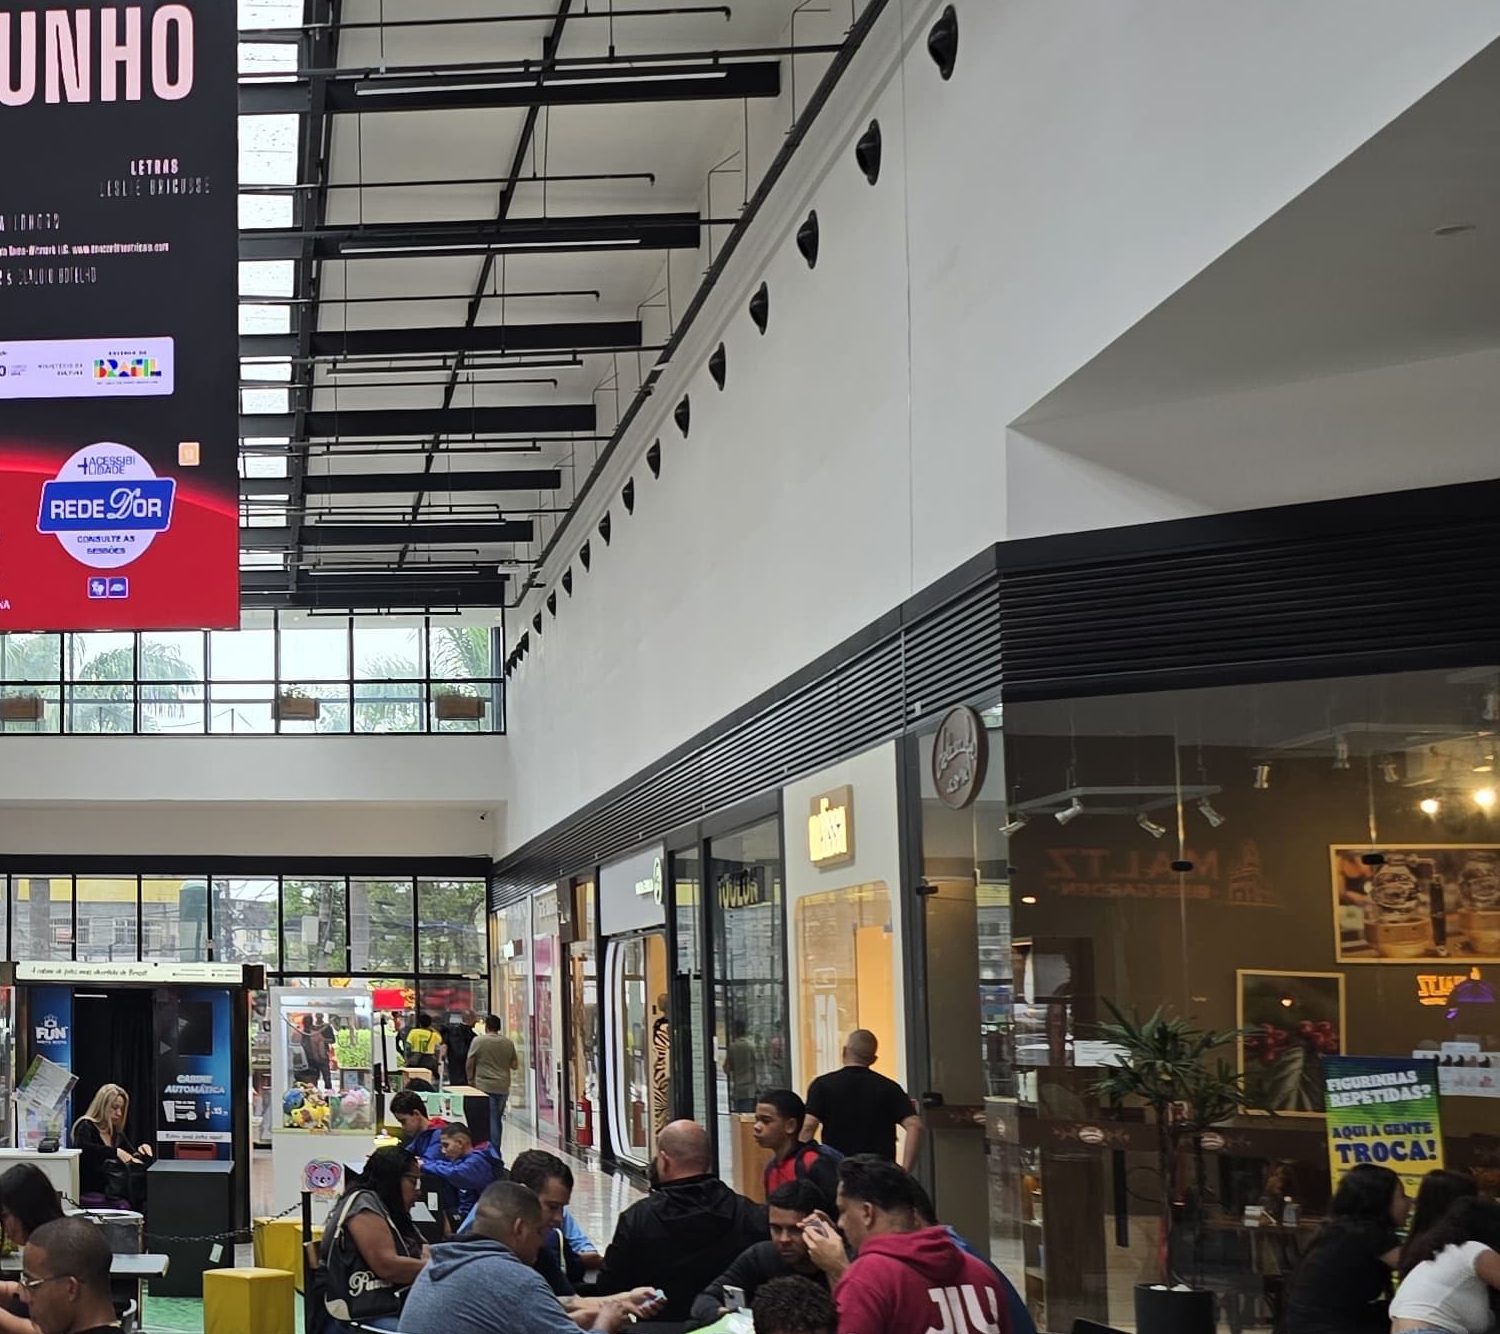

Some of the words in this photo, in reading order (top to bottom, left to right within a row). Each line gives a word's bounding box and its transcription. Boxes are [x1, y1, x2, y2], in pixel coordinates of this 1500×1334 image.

[130, 158, 179, 175] LETRAS
[51, 499, 104, 519] REDE
[36, 1027, 66, 1040] FUN
[164, 1084, 225, 1094] AUTOMÁTICA
[1326, 1070, 1418, 1092] FIGURINHAS
[1329, 1085, 1431, 1107] REPETIDAS?
[1332, 1125, 1368, 1140] AQUI
[1383, 1122, 1433, 1136] GENTE
[1335, 1140, 1437, 1163] TROCA!
